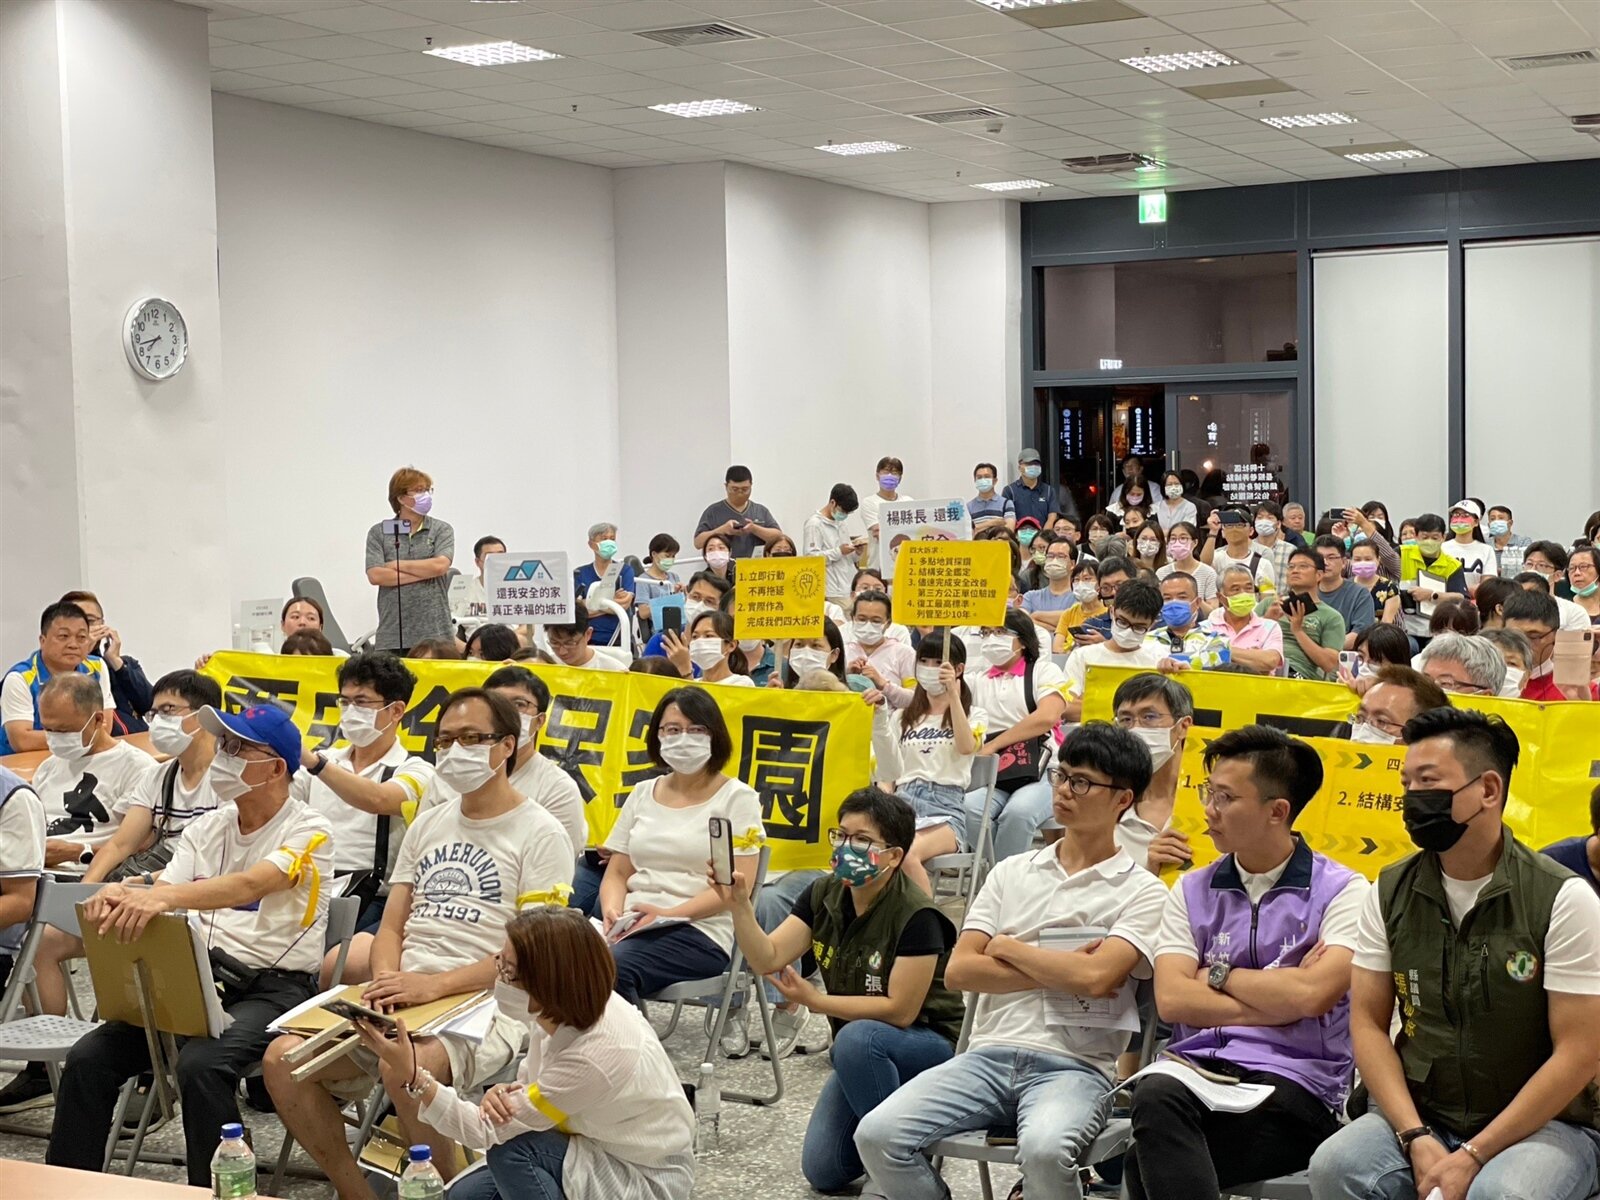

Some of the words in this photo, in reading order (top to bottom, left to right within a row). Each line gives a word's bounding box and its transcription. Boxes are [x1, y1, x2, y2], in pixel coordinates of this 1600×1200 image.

[143, 312, 150, 322] 11
[151, 308, 159, 319] 12
[163, 313, 167, 322] 1
[138, 321, 145, 332] 10
[169, 322, 174, 332] 2
[135, 333, 140, 344] 9
[172, 335, 177, 344] 3
[139, 347, 144, 357] 8
[170, 348, 175, 357] 4
[146, 355, 151, 365] 7
[155, 359, 160, 369] 6
[164, 356, 169, 366] 5
[886, 509, 927, 526] 楊縣長
[934, 507, 960, 522] 還我
[739, 573, 747, 582] 1.
[749, 570, 785, 582] 立即行動
[919, 567, 971, 576] 結構安全鑑定
[496, 587, 561, 599] 還我安全的家
[748, 586, 785, 597] 不再拖延
[918, 589, 997, 598] 第三方公正單位驗證
[492, 604, 567, 616] 真正幸福的城市
[737, 603, 746, 612] 2.
[748, 601, 784, 612] 實際作為
[747, 616, 820, 627] 完成我們四大訴求
[1337, 791, 1351, 806] 2.
[865, 973, 883, 993] 張
